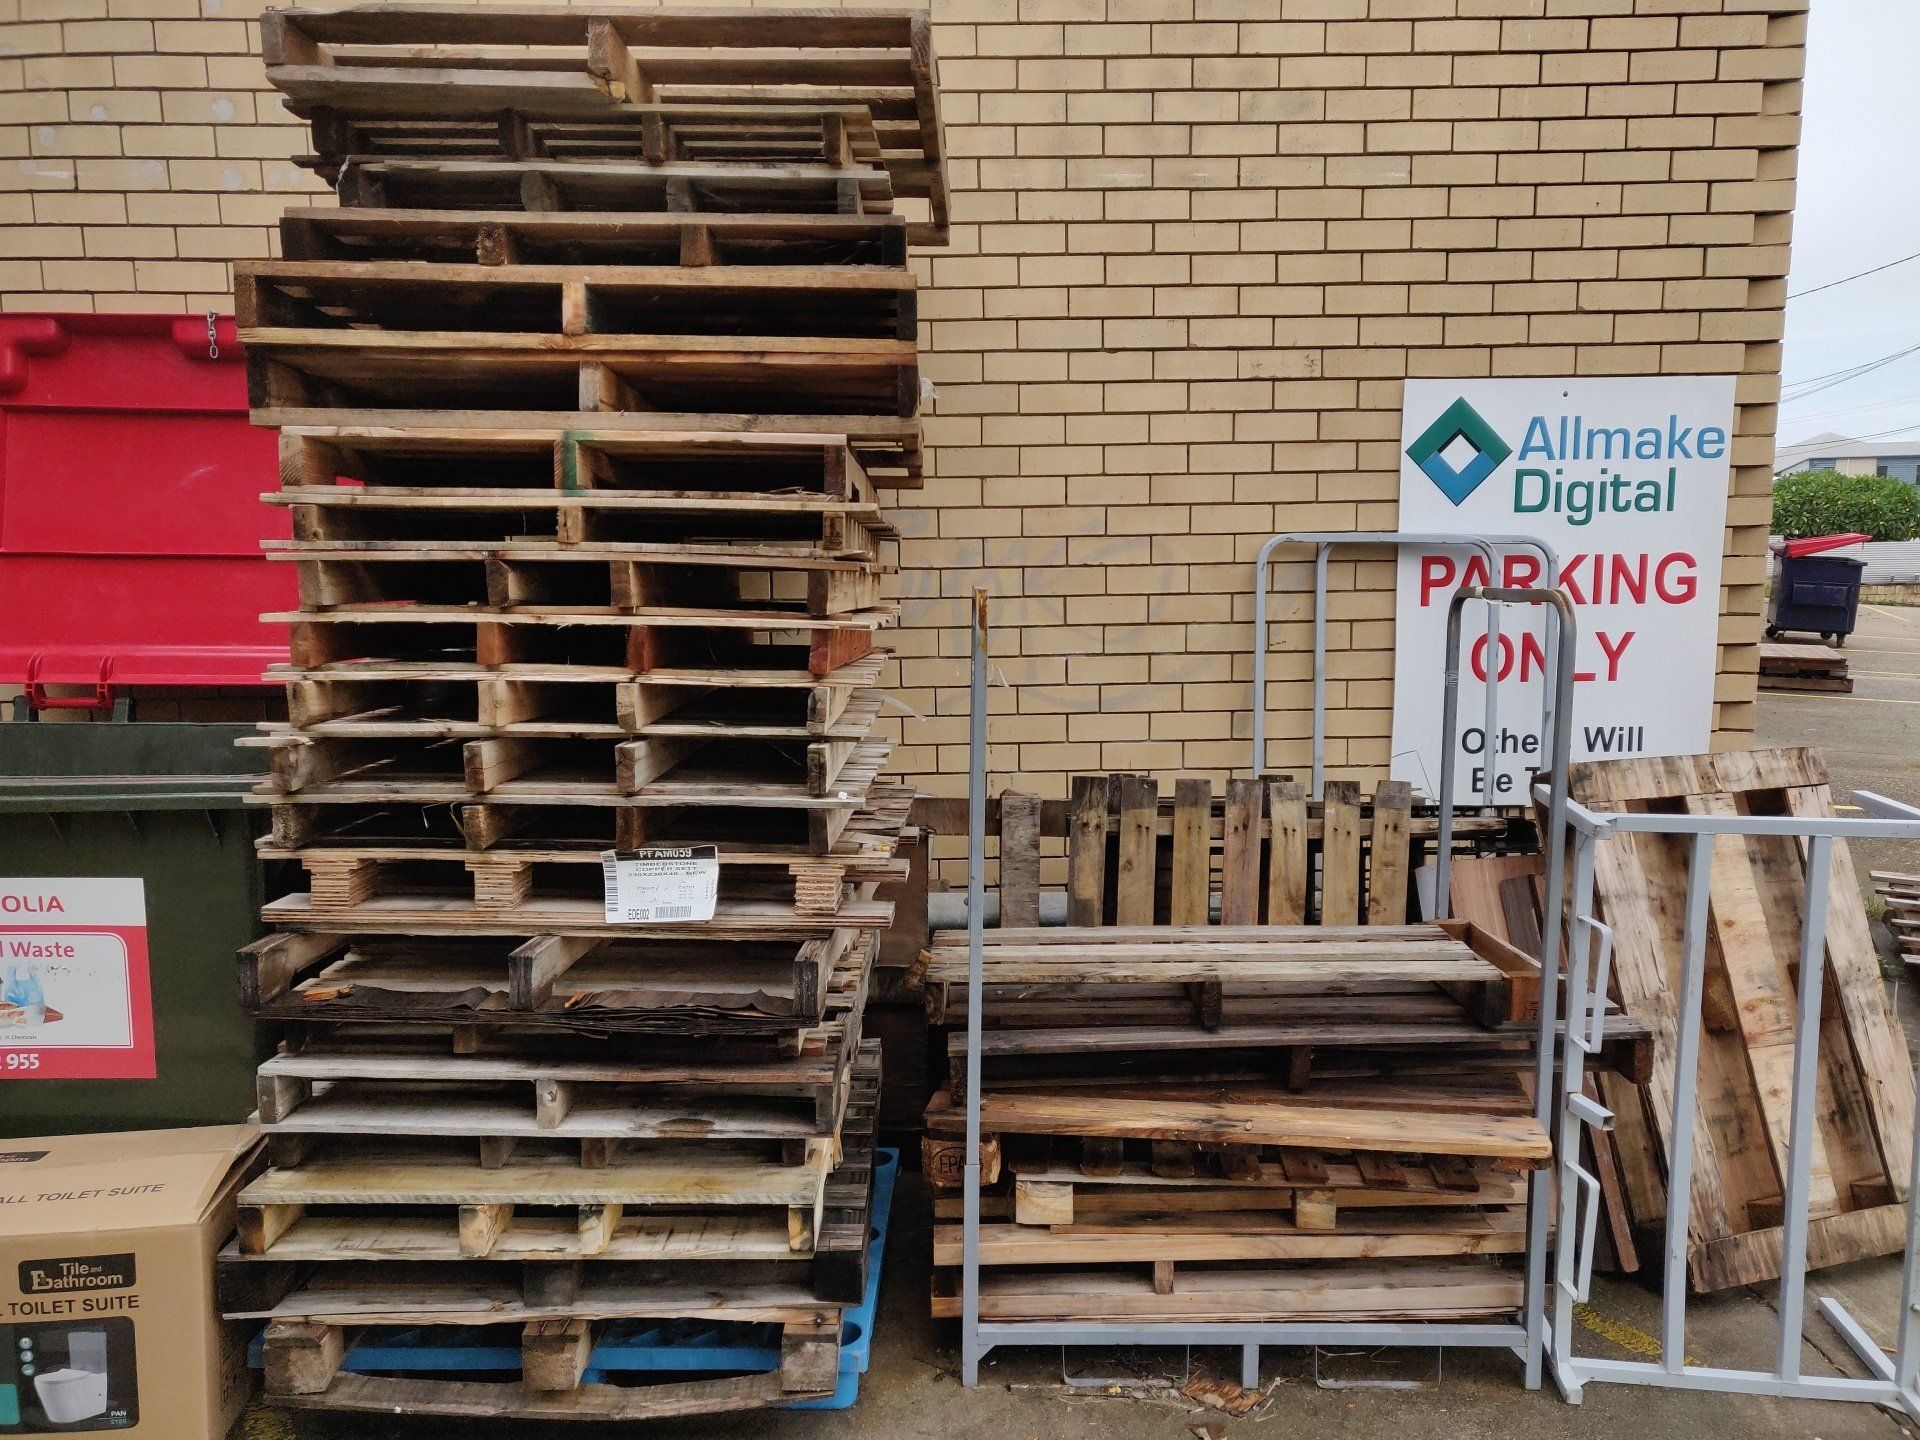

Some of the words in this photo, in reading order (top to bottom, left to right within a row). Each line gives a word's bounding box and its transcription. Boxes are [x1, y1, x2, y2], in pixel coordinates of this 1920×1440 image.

[1518, 414, 1726, 462] Allmake
[1513, 467, 1677, 526] Digital
[1420, 552, 1698, 607] PARKING
[1583, 726, 1644, 753] Will
[639, 848, 692, 859] PFAM059
[9, 941, 75, 958] Waste
[6, 1053, 40, 1070] 955
[37, 1189, 104, 1202] TOILET
[107, 1183, 166, 1197] SUITE
[59, 1262, 90, 1276] Tile
[90, 1265, 102, 1273] and
[30, 1270, 123, 1291] Bathroom
[8, 1300, 76, 1316] TOILET
[82, 1295, 140, 1312] SUITE
[111, 1410, 127, 1419] PAN
